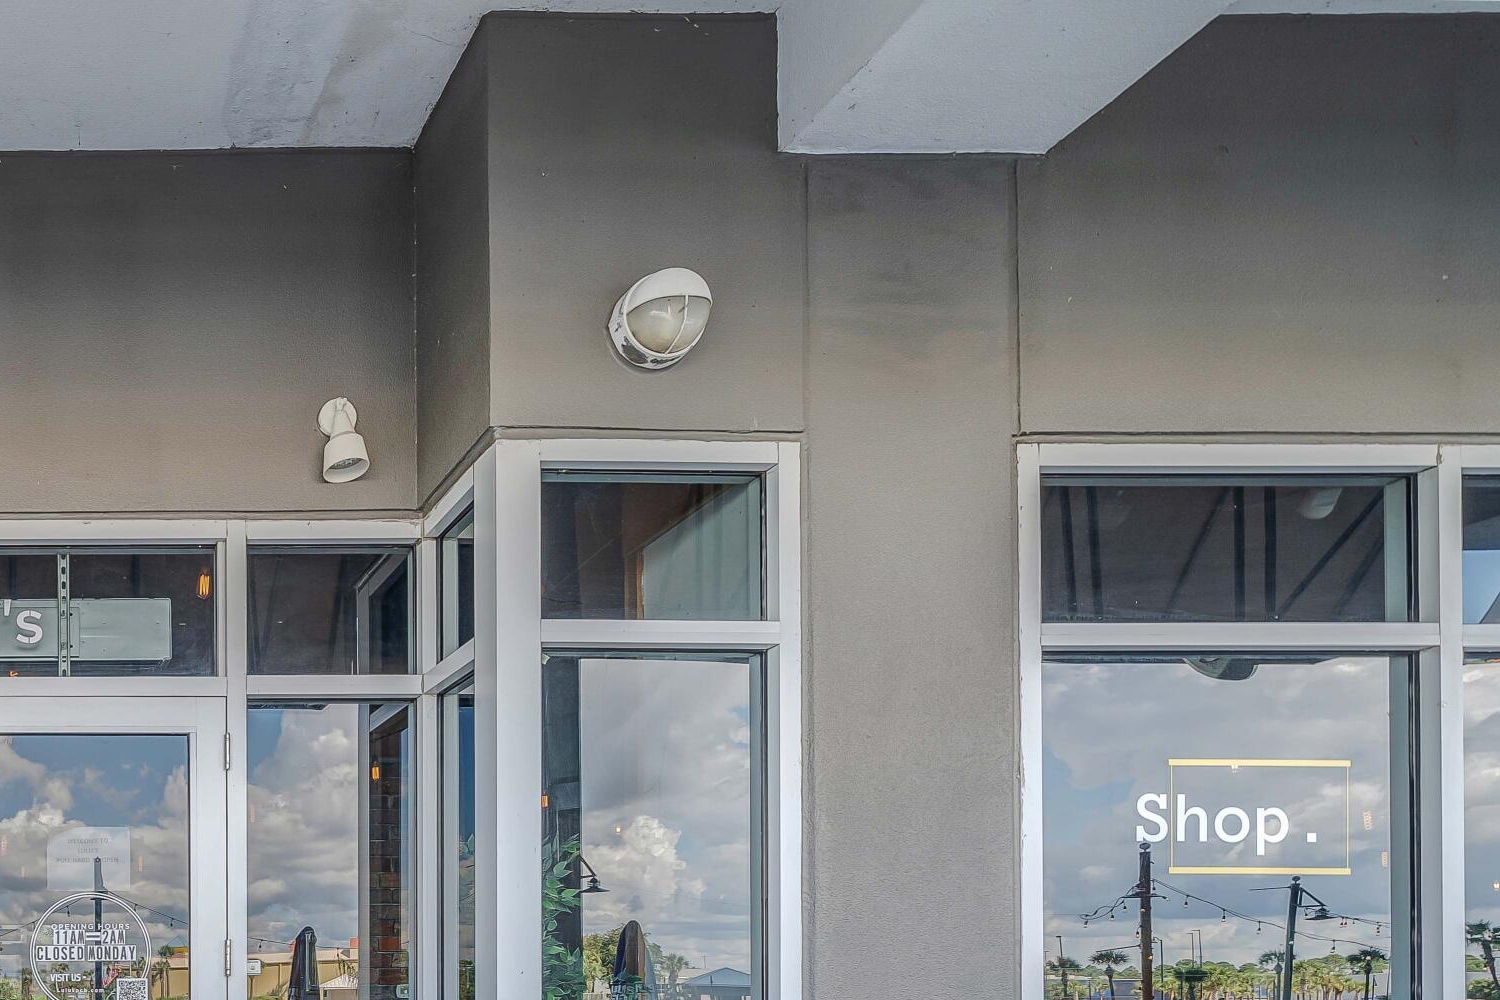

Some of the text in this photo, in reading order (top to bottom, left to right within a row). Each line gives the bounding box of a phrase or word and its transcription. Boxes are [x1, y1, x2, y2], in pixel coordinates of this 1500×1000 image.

[1135, 792, 1290, 856] Shop
[37, 946, 135, 961] CLOSED MONDAY
[50, 973, 70, 982] VISIT
[71, 973, 81, 982] US
